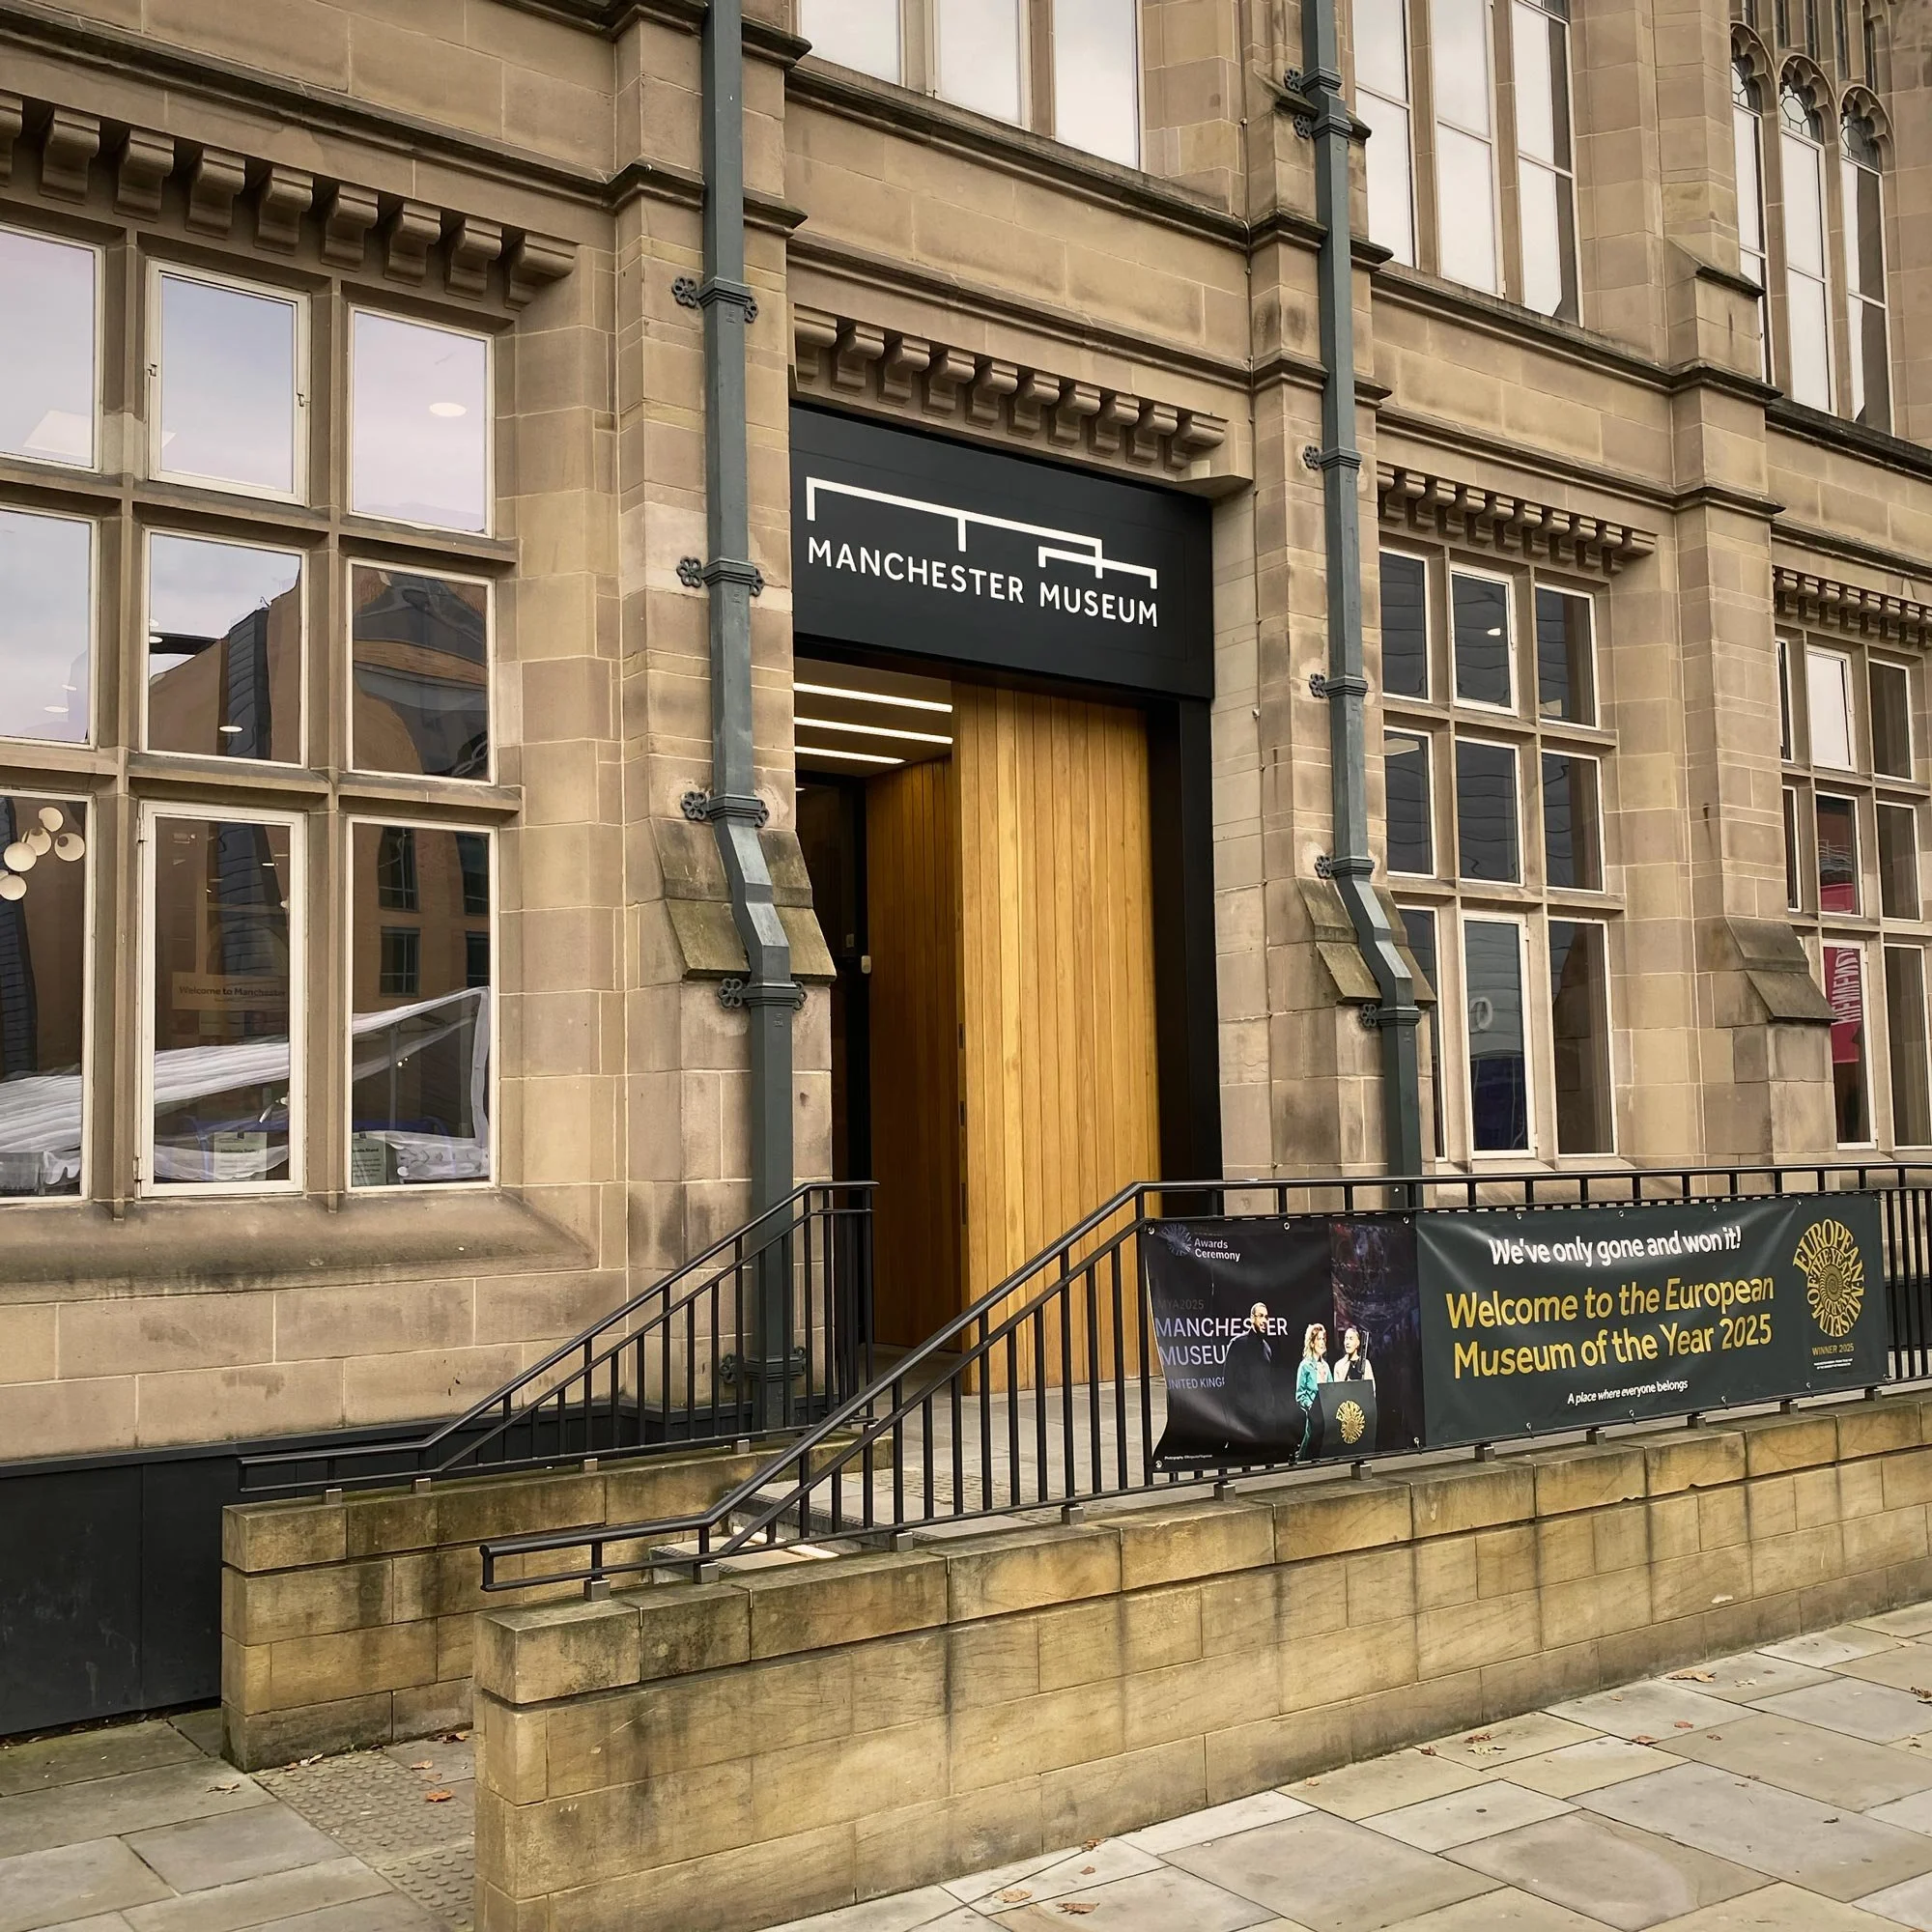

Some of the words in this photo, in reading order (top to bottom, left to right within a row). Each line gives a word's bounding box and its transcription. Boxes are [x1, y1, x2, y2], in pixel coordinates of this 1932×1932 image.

[808, 536, 1024, 604] MANCHESTER
[1039, 582, 1158, 628] MUSEUM
[179, 986, 221, 995] Welcome
[223, 986, 233, 996] to
[1194, 1237, 1229, 1249] Awards
[1195, 1248, 1241, 1263] Ceremony
[1489, 1237, 1550, 1264] We've
[1552, 1236, 1593, 1267] only
[1597, 1237, 1645, 1266] gone
[1647, 1230, 1682, 1257] and
[1682, 1233, 1722, 1254] won
[1722, 1225, 1742, 1250] it!
[1793, 1218, 1864, 1283] EUROPEAN
[1810, 1248, 1833, 1277] THE
[1445, 1290, 1578, 1329] Welcome
[1584, 1287, 1613, 1320] to
[1618, 1281, 1661, 1317] the
[1664, 1277, 1775, 1315] European
[1810, 1285, 1864, 1338] MUSEUM
[1154, 1317, 1289, 1338] MANCHESER
[1159, 1344, 1229, 1367] MUSEU
[1454, 1341, 1577, 1379] Museum
[1580, 1328, 1608, 1367] of
[1611, 1327, 1659, 1364] the
[1659, 1322, 1715, 1356] Year
[1719, 1313, 1773, 1350] 2025
[1811, 1345, 1838, 1356] WINNER
[1838, 1343, 1855, 1353] 2025
[1200, 1377, 1226, 1388] KING
[1567, 1393, 1575, 1405] A
[1575, 1391, 1598, 1406] place
[1598, 1389, 1621, 1401] where
[1621, 1384, 1657, 1398] everyone
[1656, 1379, 1689, 1392] belongs
